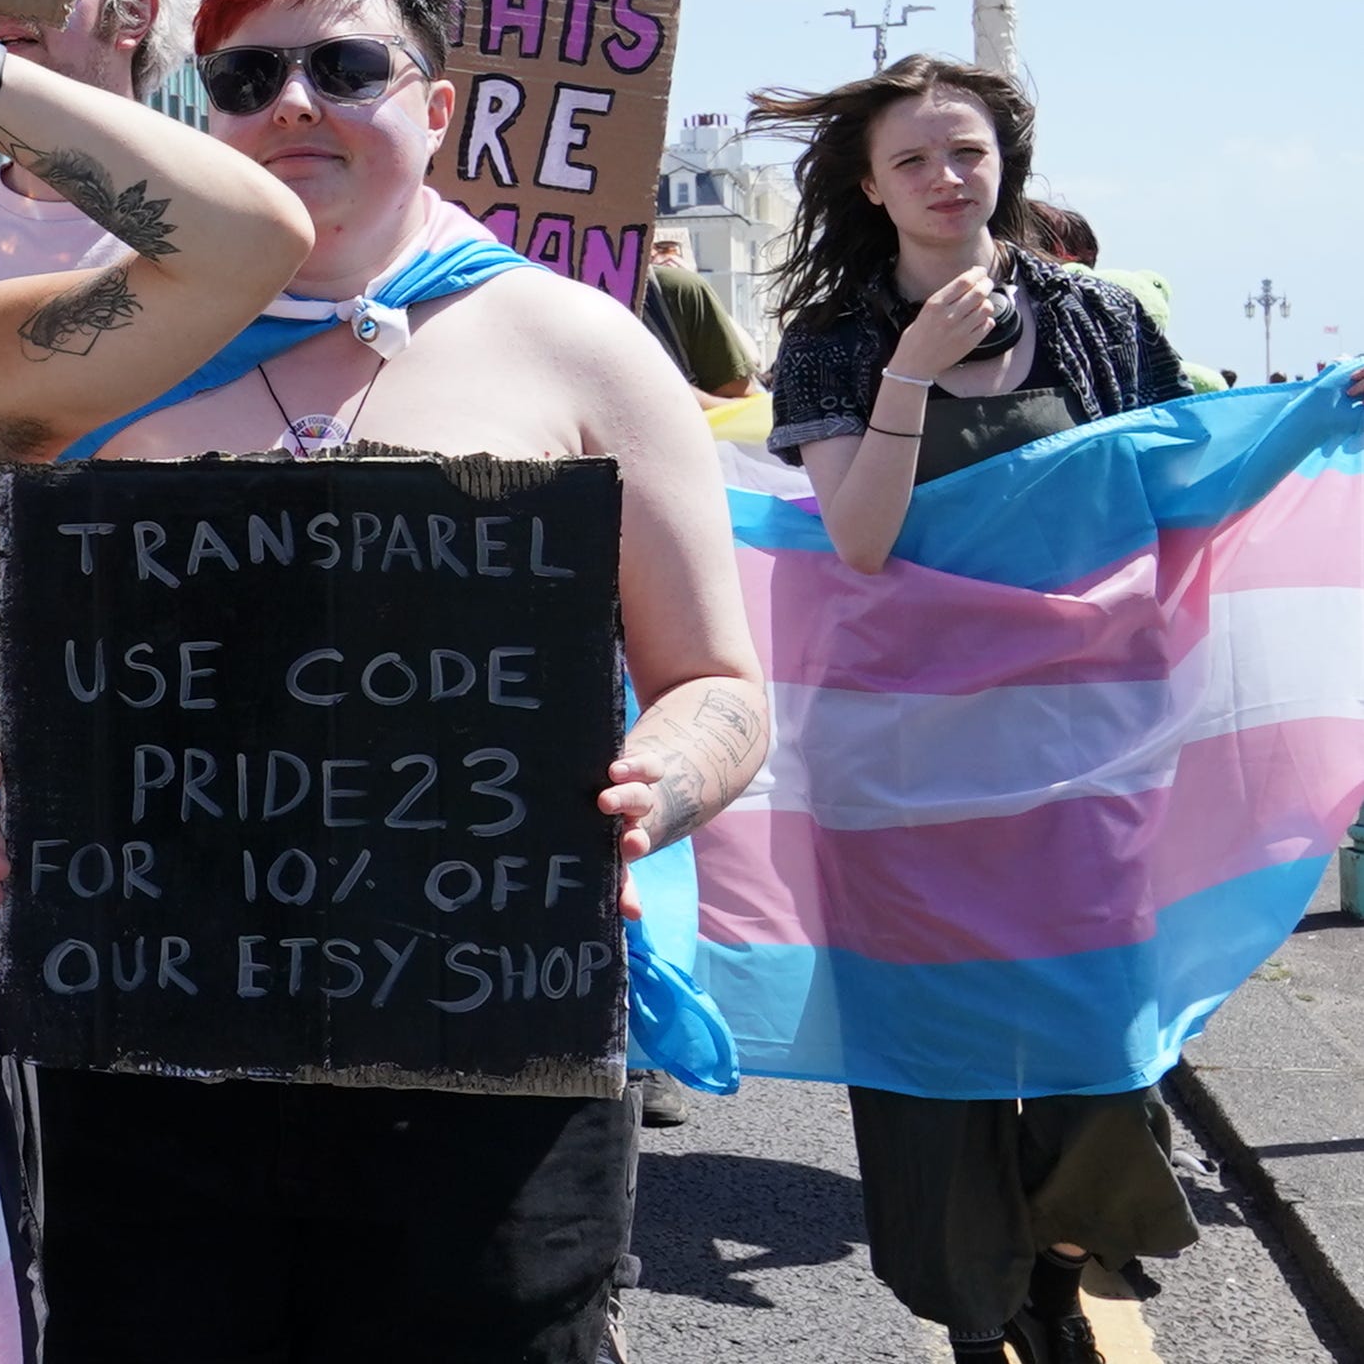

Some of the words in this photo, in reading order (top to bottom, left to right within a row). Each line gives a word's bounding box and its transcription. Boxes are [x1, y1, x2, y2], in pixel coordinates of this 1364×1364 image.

[58, 511, 575, 588] TRANSPAREL
[65, 639, 223, 709] USE
[286, 646, 541, 708] CODE
[132, 744, 527, 836] PRIDE23
[30, 839, 162, 899] FOR
[244, 848, 375, 907] 10%
[425, 854, 583, 911] OFF
[43, 935, 198, 996] OUR
[237, 935, 418, 1008] ETSY
[428, 941, 612, 1013] SHOP
